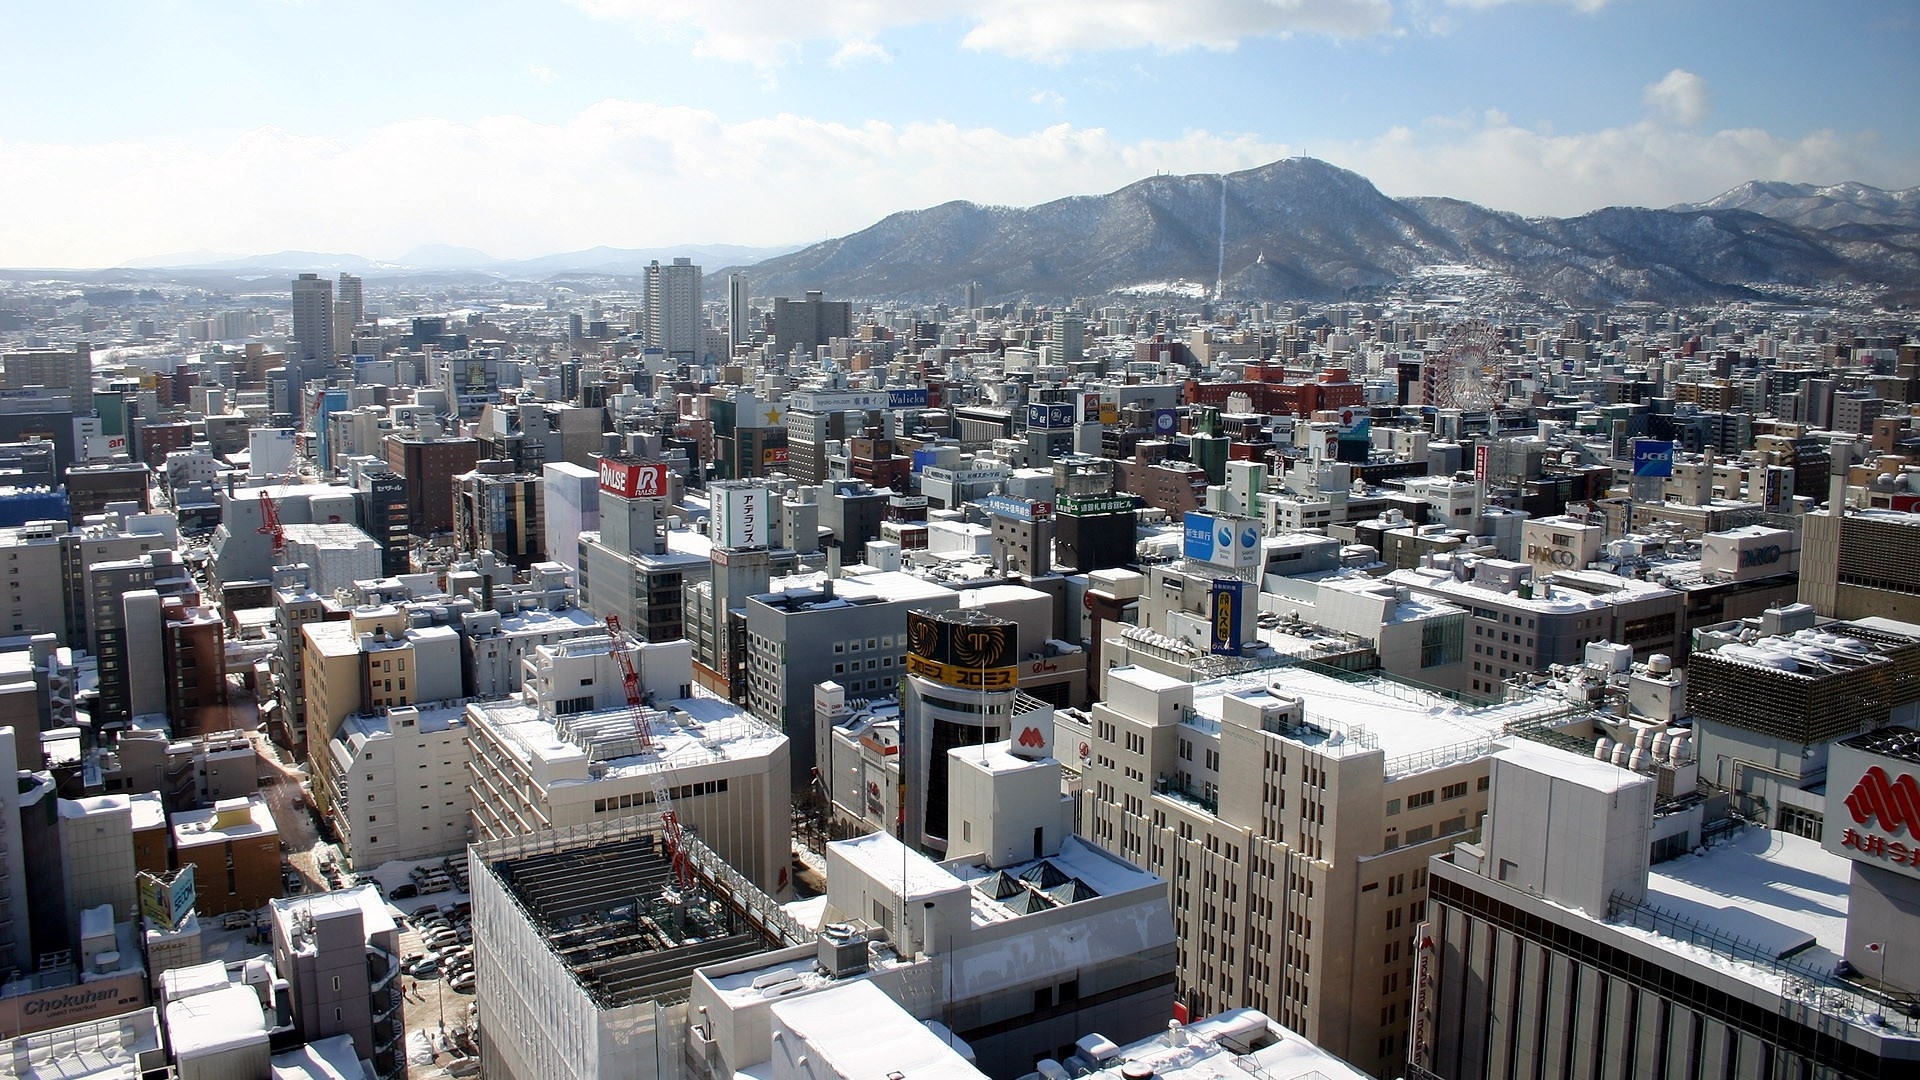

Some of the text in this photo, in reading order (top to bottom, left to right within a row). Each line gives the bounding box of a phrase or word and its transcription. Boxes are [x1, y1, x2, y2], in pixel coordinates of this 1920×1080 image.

[403, 411, 410, 419] P
[109, 438, 125, 448] an
[1636, 452, 1669, 460] JCB
[1186, 528, 1211, 541] 新生銀行
[1528, 543, 1575, 567] PARCO
[1741, 545, 1781, 569] PARCO
[910, 657, 943, 681] プロミス
[956, 670, 1011, 686] プロミス
[24, 987, 119, 1015] Chokuhan
[46, 1003, 98, 1018] used market
